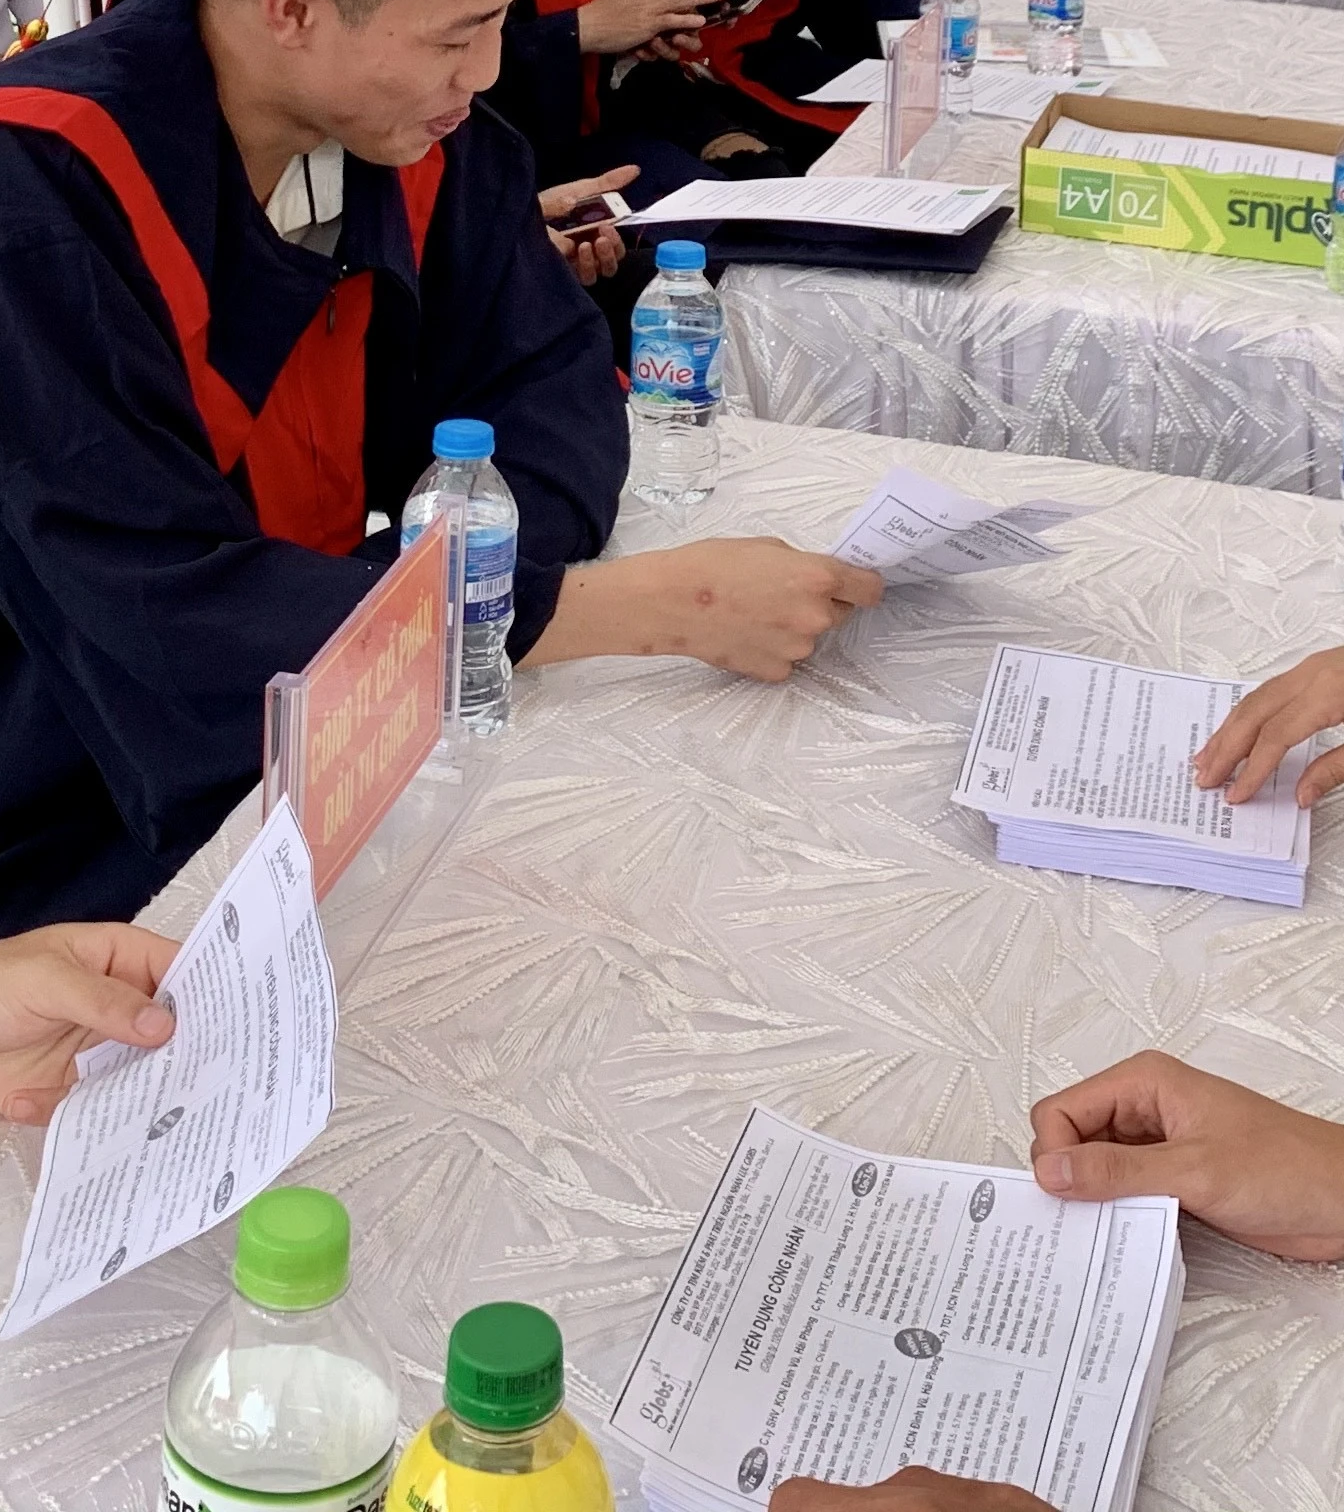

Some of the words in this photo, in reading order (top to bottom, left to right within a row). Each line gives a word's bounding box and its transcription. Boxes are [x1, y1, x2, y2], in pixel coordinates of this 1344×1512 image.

[1062, 184, 1109, 214] A4
[1118, 190, 1159, 220] 70
[1227, 195, 1316, 243] plus
[310, 693, 353, 786] CÔNG
[356, 667, 373, 730] TY
[777, 1222, 806, 1260] NHÂN
[762, 1255, 793, 1295] CÔNG
[751, 1292, 782, 1333] DỤNG
[729, 1327, 764, 1374] TUYỂN
